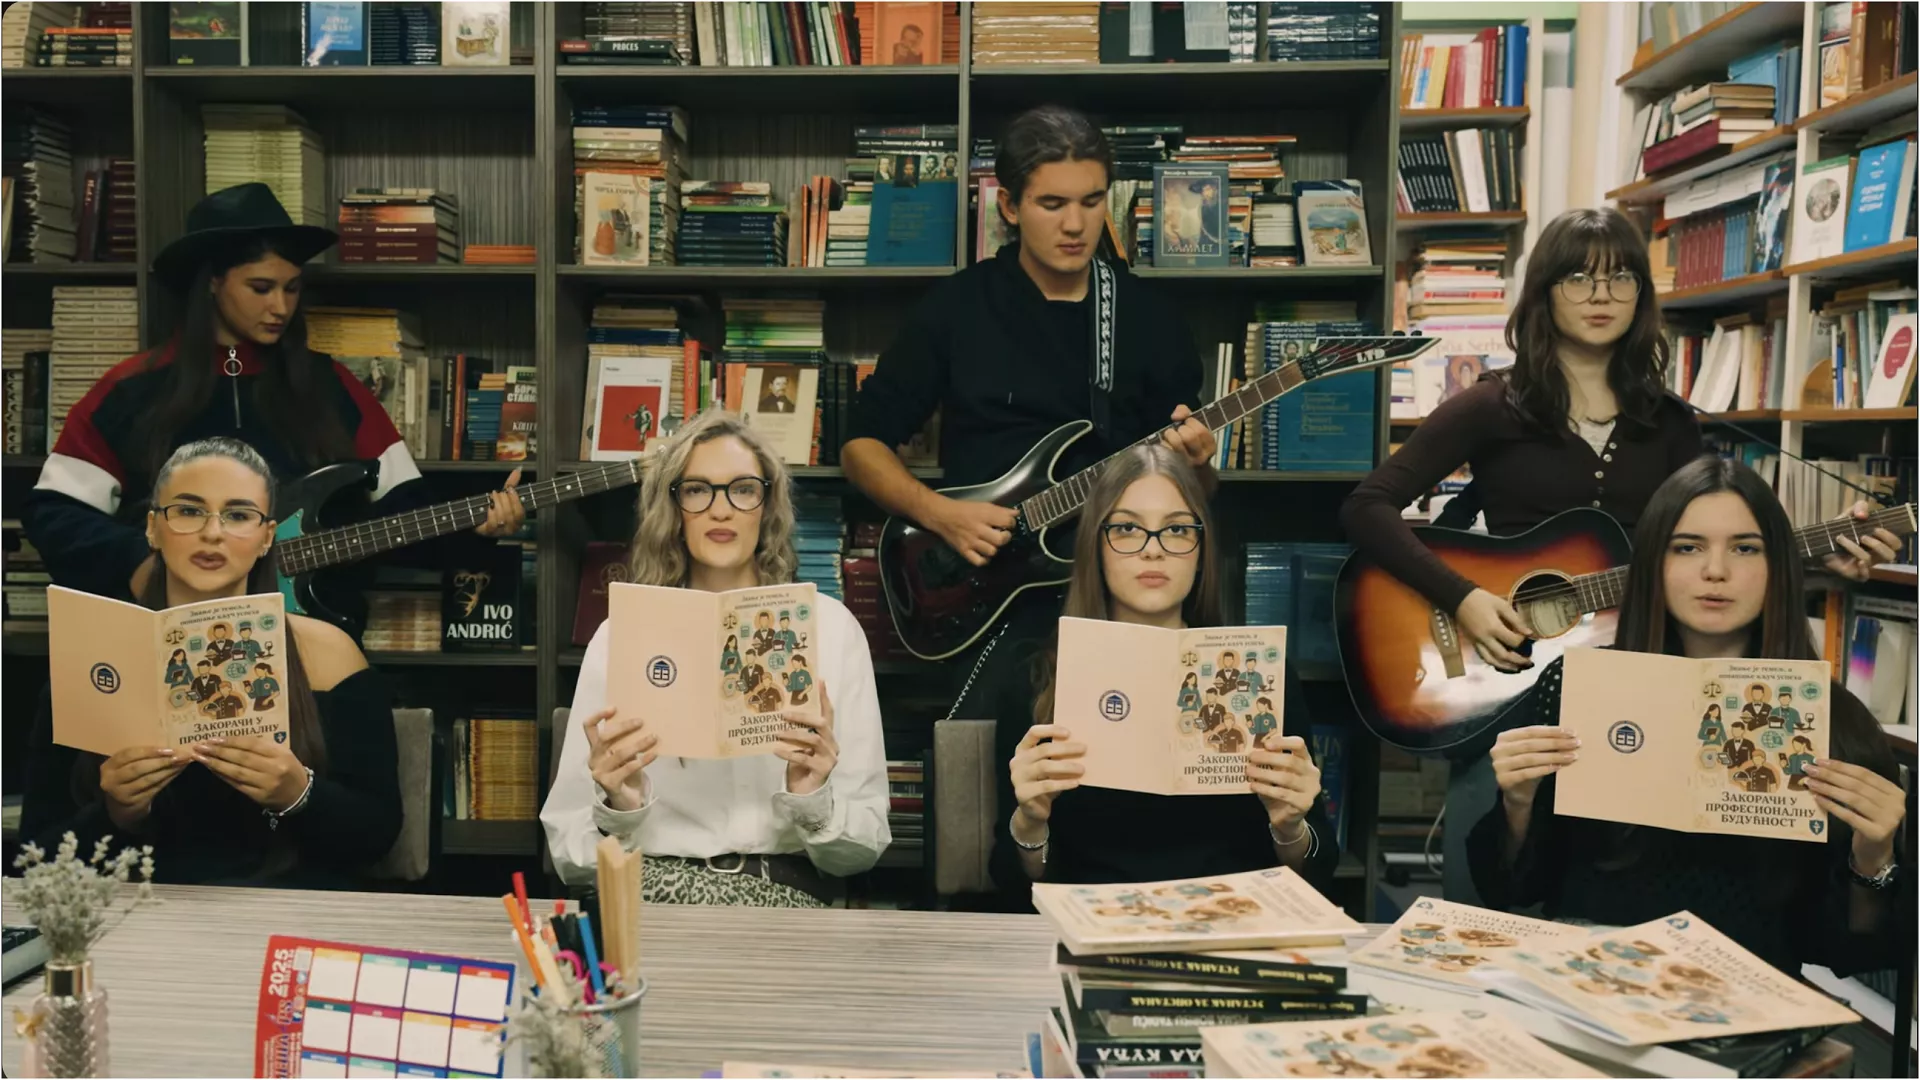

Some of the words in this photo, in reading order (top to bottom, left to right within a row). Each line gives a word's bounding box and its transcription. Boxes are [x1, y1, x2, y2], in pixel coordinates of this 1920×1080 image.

[612, 42, 640, 52] PROCES
[1168, 243, 1214, 253] ХАМЛЕТ
[1356, 348, 1386, 364] LTD
[484, 604, 513, 620] IVO
[446, 620, 513, 639] ANDRIĆ
[194, 718, 253, 733] ЗАКОРАЧИ
[256, 716, 263, 724] У
[740, 714, 785, 726] ЗАКОРАЧ
[179, 724, 280, 745] ПРОФЕСИОНАЛНУ
[1198, 774, 1256, 785] БУДУЋНОС
[1722, 791, 1786, 806] ЗАКОРАЧИ
[1790, 797, 1797, 806] У
[1705, 802, 1816, 818] ПРОФЕСИОНАЛНУ
[1721, 814, 1796, 828] БУДУЋНОСТ
[268, 948, 290, 996] 2025
[1168, 960, 1185, 970] ЗА
[1186, 962, 1240, 976] УСТАНАК
[1131, 996, 1194, 1007] ОПСТАНАК
[1194, 998, 1208, 1008] ЗА
[1212, 999, 1264, 1009] УСТАНАК
[1132, 1015, 1173, 1029] TADIĆU
[1096, 1048, 1160, 1062] КУЋА
